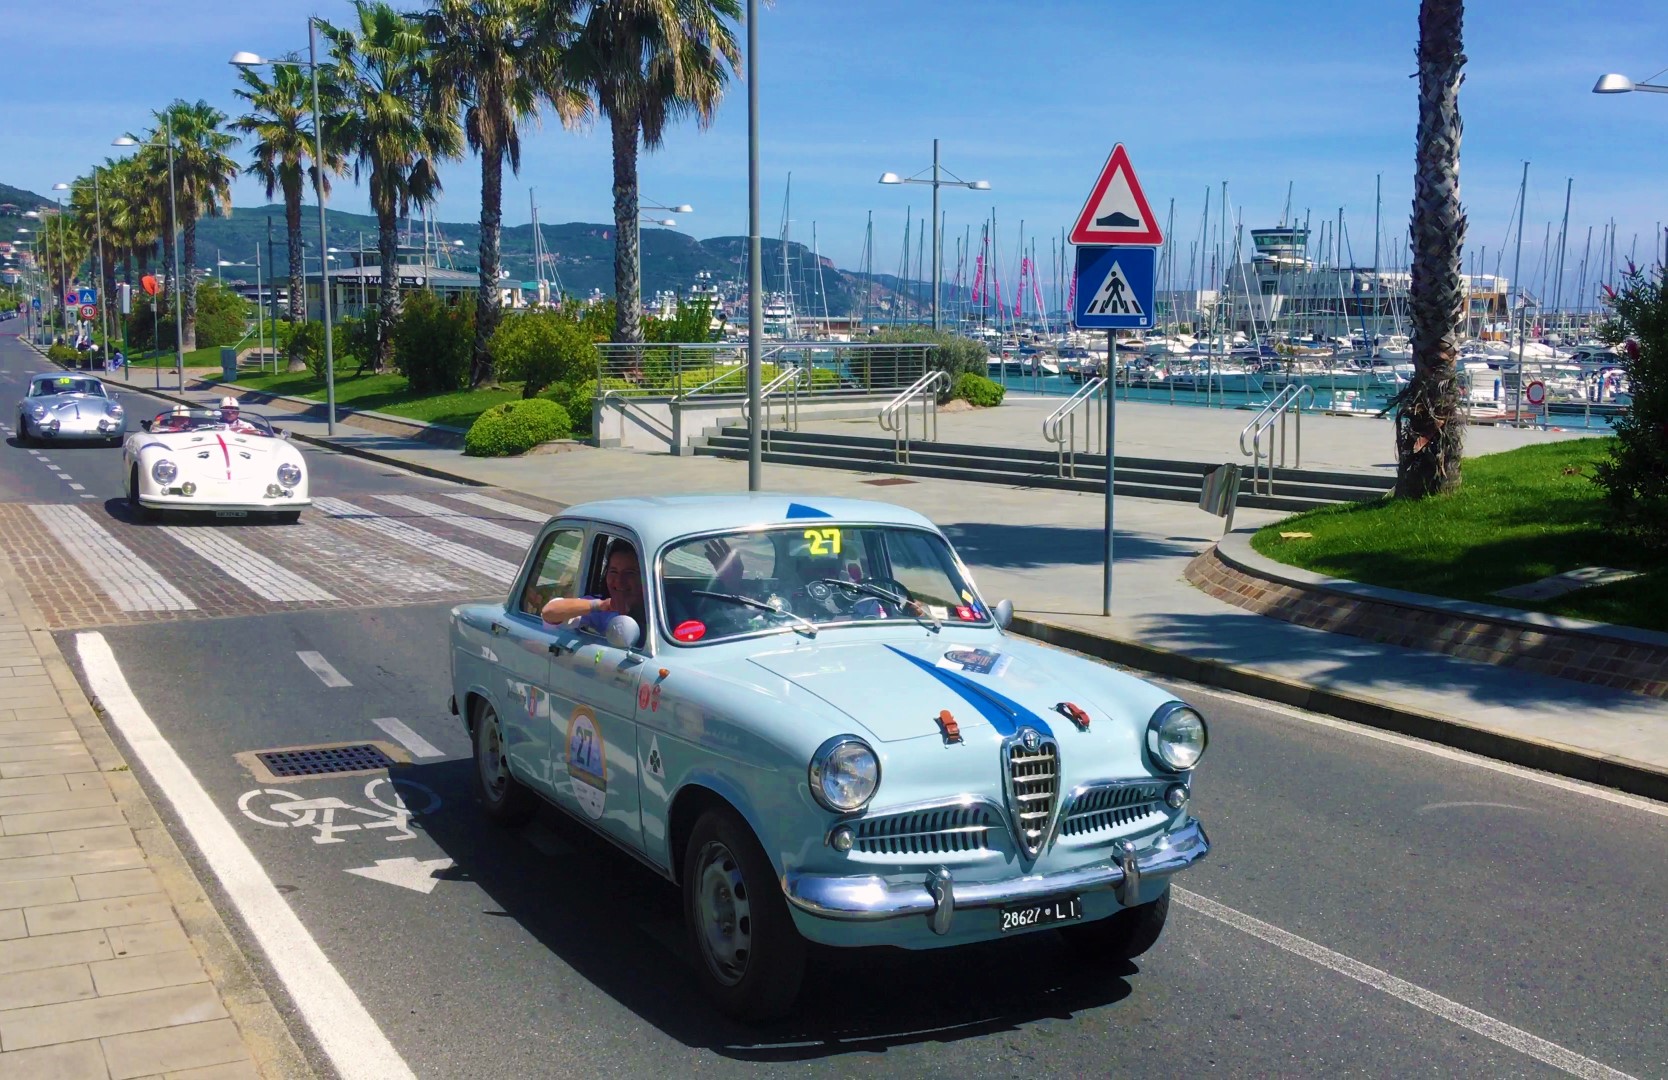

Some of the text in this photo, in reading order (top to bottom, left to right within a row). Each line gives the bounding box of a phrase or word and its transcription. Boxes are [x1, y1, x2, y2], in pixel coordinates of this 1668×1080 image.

[804, 528, 841, 555] 27
[575, 726, 593, 768] 27
[1003, 907, 1041, 928] 28627
